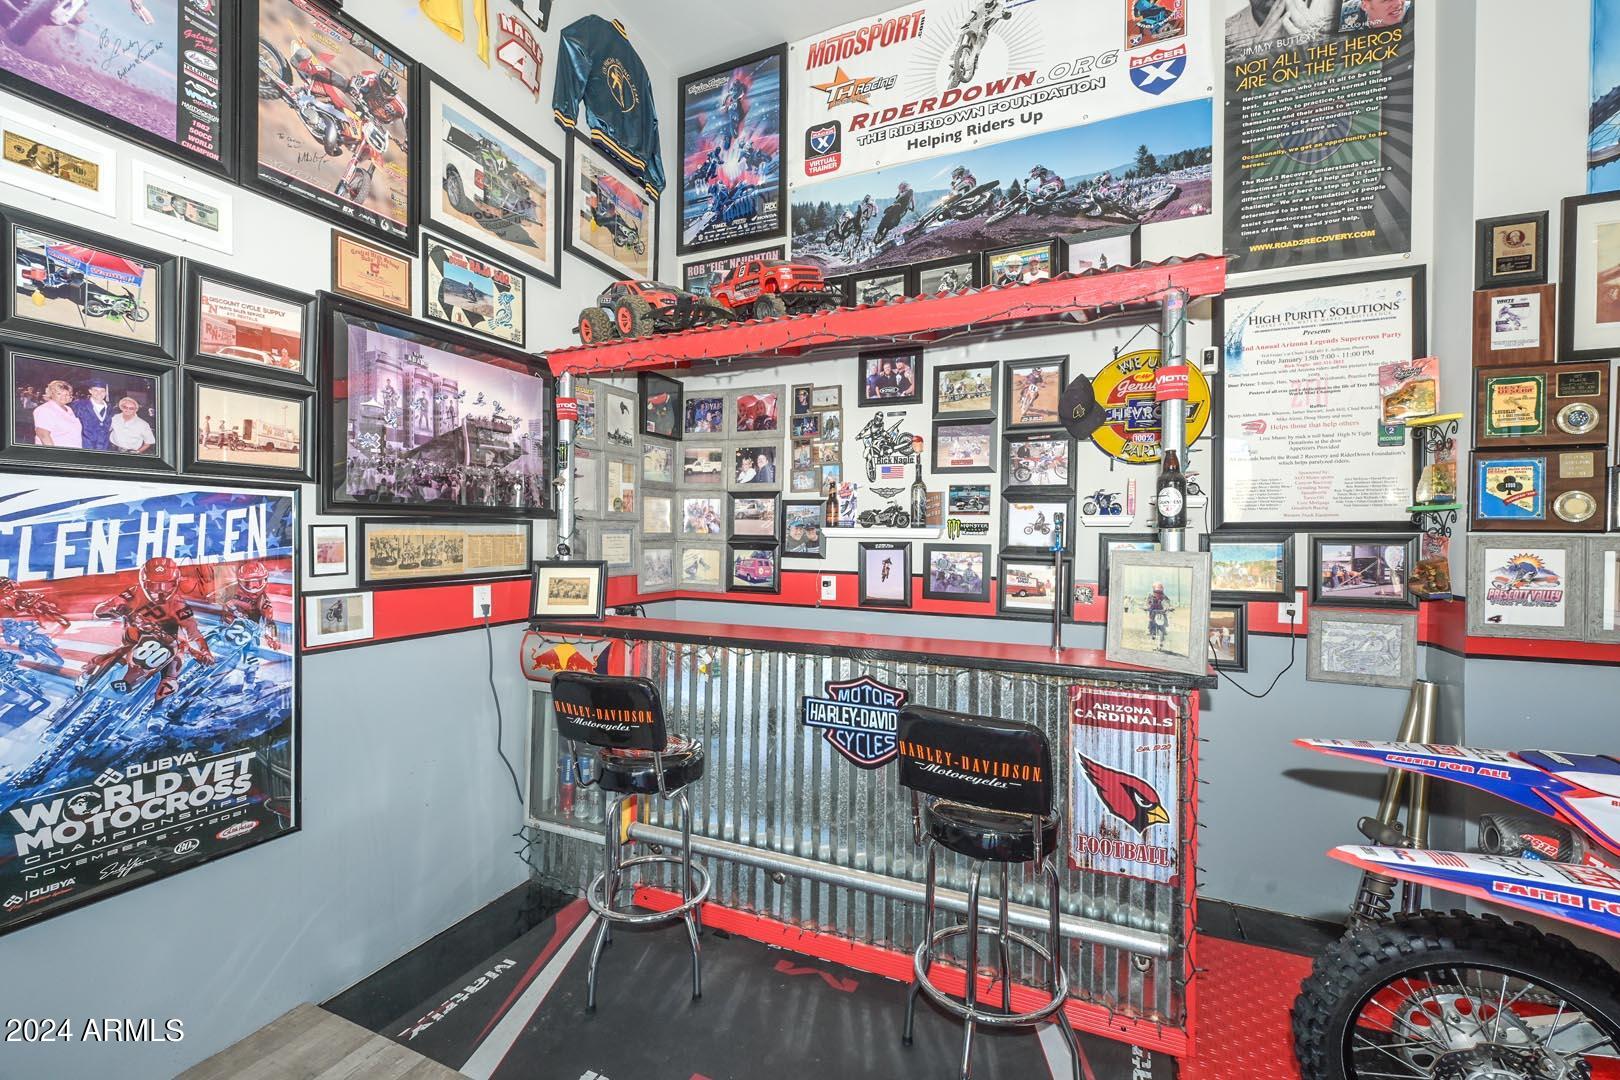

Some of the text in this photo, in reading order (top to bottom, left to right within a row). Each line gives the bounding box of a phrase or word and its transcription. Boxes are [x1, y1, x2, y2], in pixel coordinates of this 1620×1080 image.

[1341, 18, 1384, 31] DOUG HENRY
[500, 13, 543, 63] NAGLE
[1241, 33, 1316, 57] JIMMY BUTTON
[1132, 48, 1185, 68] RACER
[1235, 28, 1402, 77] NOT ALL THE HEROS
[496, 38, 541, 98] 4
[1138, 60, 1177, 87] X
[1235, 44, 1399, 92] ARE ON THE TRACK
[856, 74, 898, 93] Racing
[1295, 90, 1326, 99] sacrifice
[1342, 82, 1366, 90] normal
[1369, 76, 1392, 86] things
[1242, 94, 1266, 102] Heroes
[1250, 109, 1261, 118] life
[1272, 104, 1292, 114] study,
[1303, 96, 1335, 108] practice,
[1347, 86, 1386, 99] strengthen
[857, 76, 1106, 146] THE RIDERDOWN FOUNDATION
[907, 111, 1043, 150] Helping Riders Up
[181, 140, 219, 160] CHAMPION
[188, 135, 213, 150] WORLD
[1242, 150, 1287, 161] Occasionally,
[1325, 135, 1366, 147] opportunity
[809, 162, 837, 173] TRAINER
[810, 156, 836, 167] VIRTUAL
[1250, 230, 1376, 252] WWW.ROAD2RECOVERY.COM
[688, 264, 705, 276] ROB
[707, 260, 728, 272] "FIG"
[209, 297, 241, 308] DISCOUNT
[241, 302, 261, 312] CYCLE
[262, 307, 286, 317] SUPPLY
[1249, 314, 1283, 326] HIGH
[1285, 309, 1327, 322] PURITY
[1330, 302, 1400, 317] SOLUTIONS
[1310, 337, 1338, 346] Legends
[1340, 334, 1380, 342] Supercross
[1278, 357, 1302, 365] January
[1117, 379, 1156, 398] Genu
[1122, 440, 1161, 458] PART
[1133, 433, 1155, 442] 100%
[876, 455, 914, 466] Rick Nagle
[136, 502, 268, 569] HELEN
[1488, 588, 1563, 602] PRESCOTT VALLEY
[133, 640, 170, 671] 80
[838, 684, 895, 706] MOTOR
[555, 700, 653, 723] HARLEY-DAVIDSON
[809, 702, 897, 732] HARLEY-DAVID
[1074, 709, 1174, 728] CARDINALS
[1093, 702, 1153, 715] ARIZONA
[571, 717, 631, 731] Motorcycles
[836, 730, 896, 758] CYCLES
[126, 751, 197, 778] DUBYA
[899, 740, 1042, 782] HARLEY-DAVIDSON
[1386, 754, 1512, 781] FAITH FOR ALL
[920, 763, 1009, 789] Motorcycles
[9, 751, 257, 832] WORLD VET
[14, 773, 253, 857] MOTOCROSS
[24, 794, 248, 866] CHAMPIONSHIPS
[25, 839, 148, 882] NOVEMBER
[208, 809, 247, 825] 2021
[1076, 834, 1170, 867] FOOTBALL
[29, 877, 74, 899] DUBYA
[1493, 881, 1620, 917] FAITH FO
